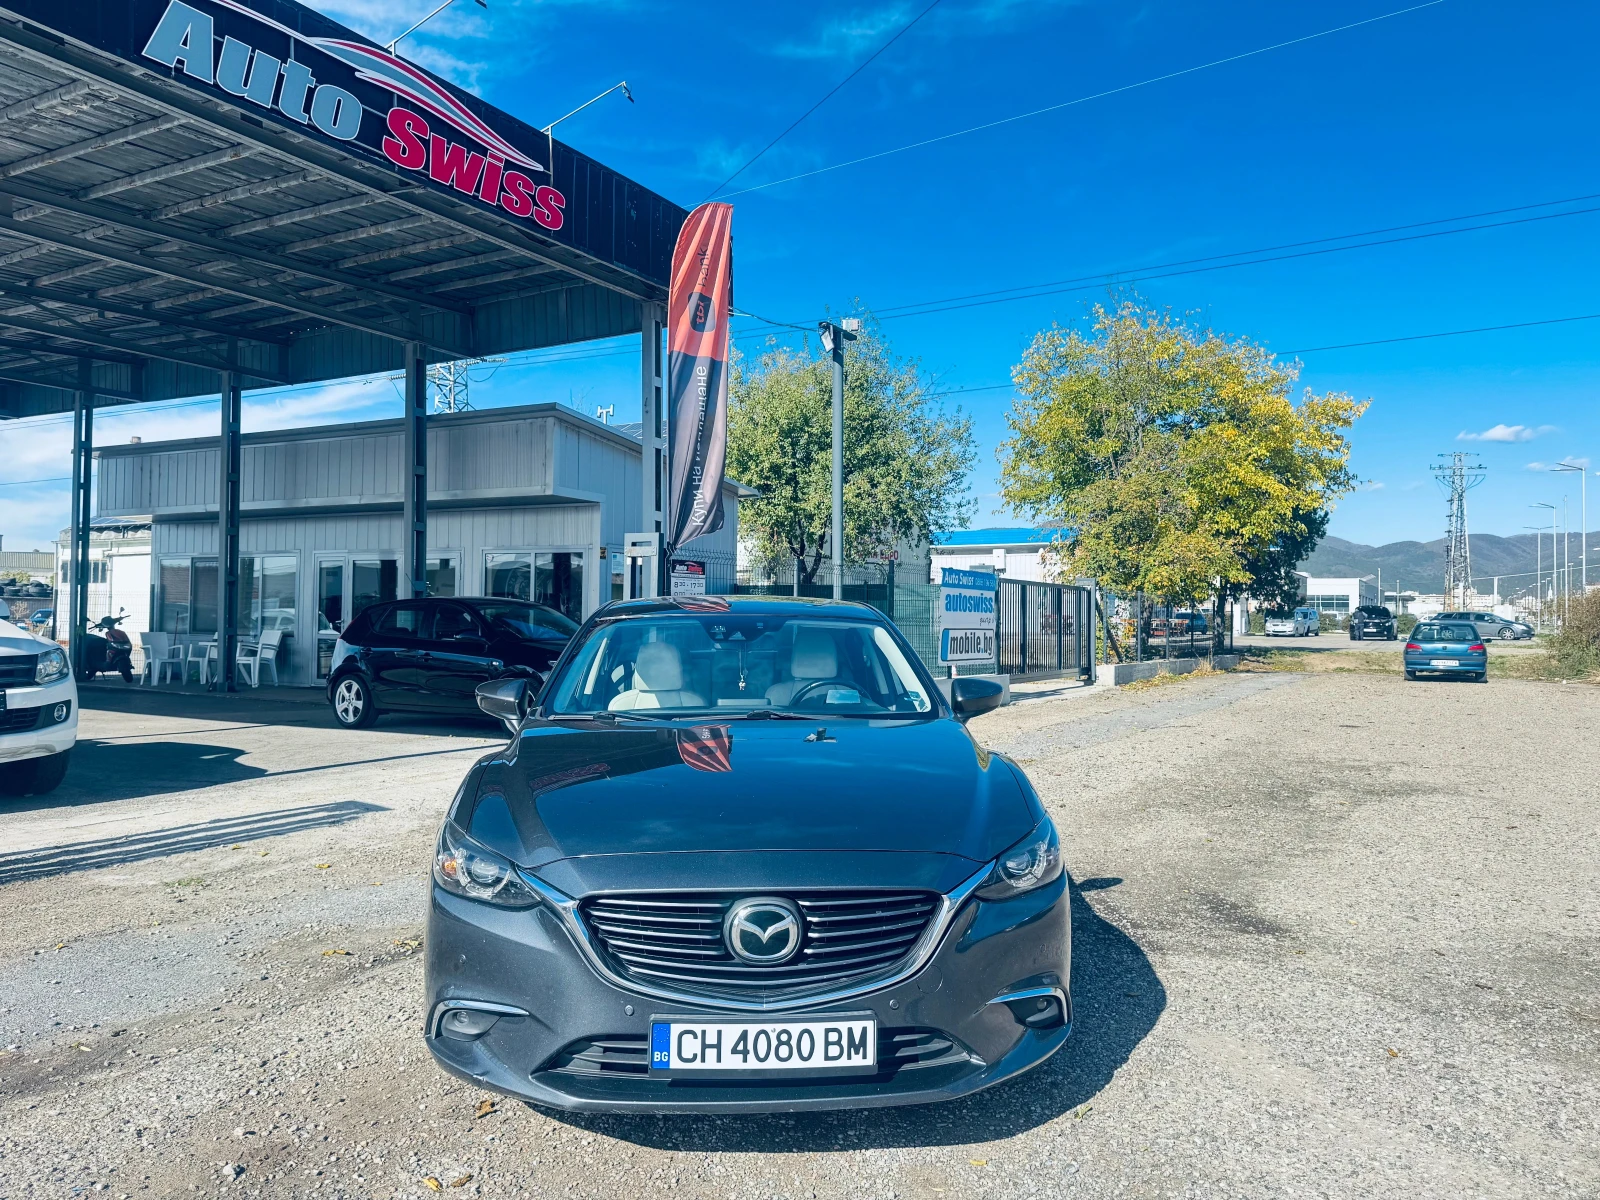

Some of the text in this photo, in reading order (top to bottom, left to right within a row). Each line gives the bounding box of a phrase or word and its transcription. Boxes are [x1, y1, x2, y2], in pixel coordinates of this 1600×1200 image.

[141, 0, 566, 231] Auto Swiss
[696, 246, 709, 324] tbi bank
[692, 466, 702, 485] на
[692, 490, 707, 526] Купи
[944, 571, 958, 585] Auto
[959, 573, 975, 586] Swiss
[949, 632, 993, 656] mobile.bg
[653, 1051, 669, 1062] BG
[676, 1026, 868, 1063] CH 4080 BM
